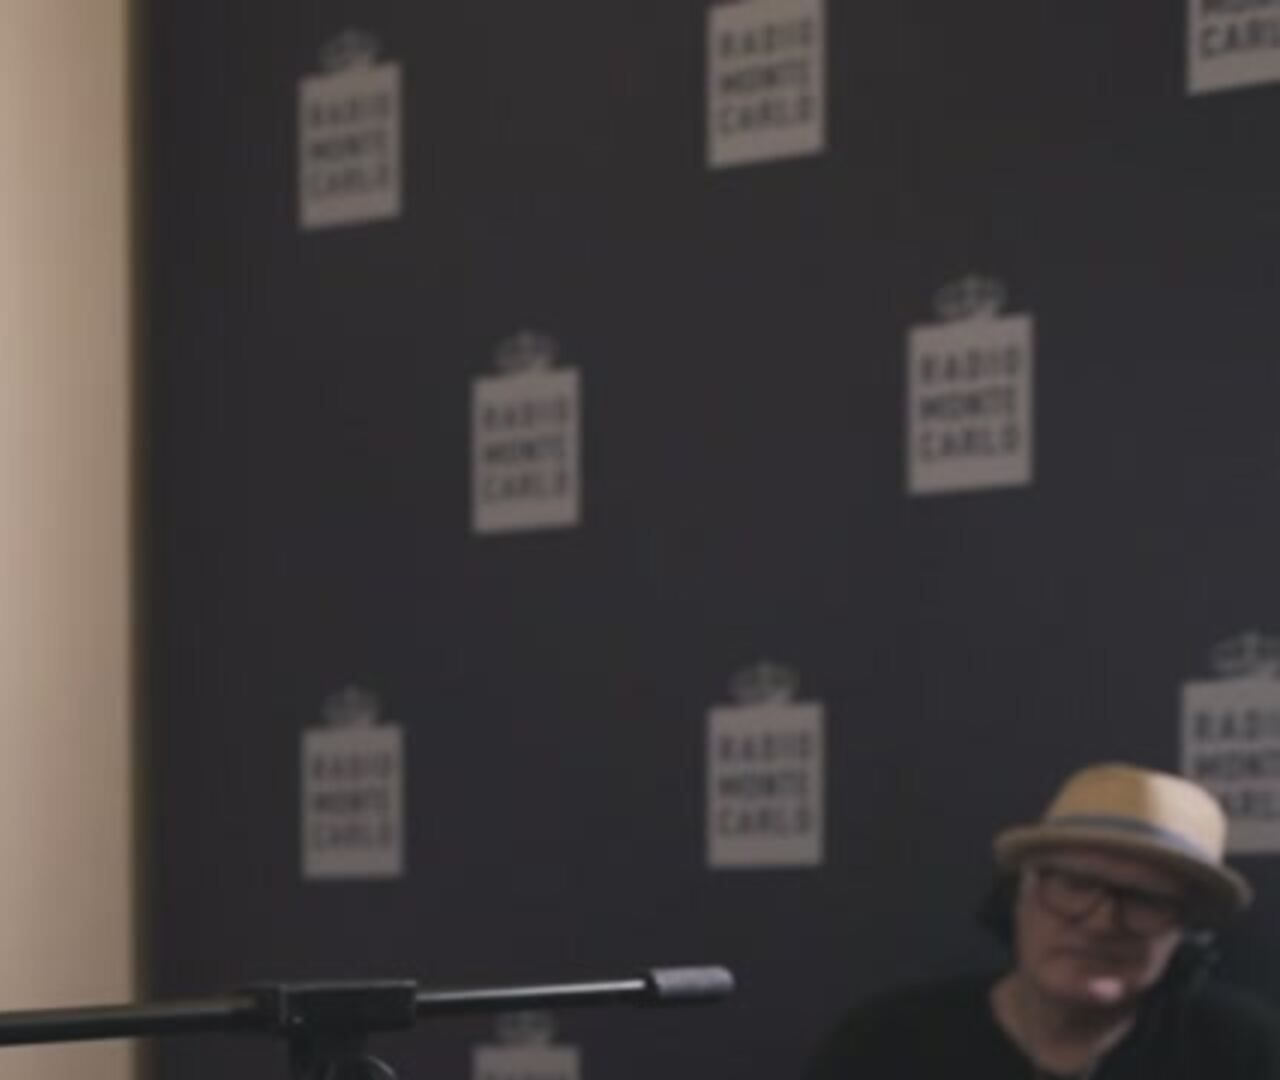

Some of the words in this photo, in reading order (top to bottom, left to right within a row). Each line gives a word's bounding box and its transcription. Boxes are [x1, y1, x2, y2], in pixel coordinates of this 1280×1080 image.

[719, 17, 814, 59] RADIO
[1200, 18, 1280, 61] CARL
[719, 57, 811, 95] MONTE
[308, 92, 393, 130] RADIO
[719, 96, 815, 138] CARLO
[308, 129, 390, 161] MONTE
[308, 162, 392, 200] CARLO
[920, 345, 1022, 387] RADIO
[483, 394, 570, 433] RADIO
[919, 384, 1018, 421] MONTE
[484, 433, 567, 466] MONTE
[918, 424, 1022, 464] CARLO
[482, 470, 570, 504] CARLO
[1195, 711, 1280, 742] RADI
[718, 729, 815, 766] RADIO
[1195, 750, 1280, 781] MONT
[311, 752, 394, 783] RADIO
[718, 770, 811, 801] MONTE
[312, 787, 390, 817] MONTE
[310, 821, 393, 851] CARLO
[717, 804, 815, 840] CARLO
